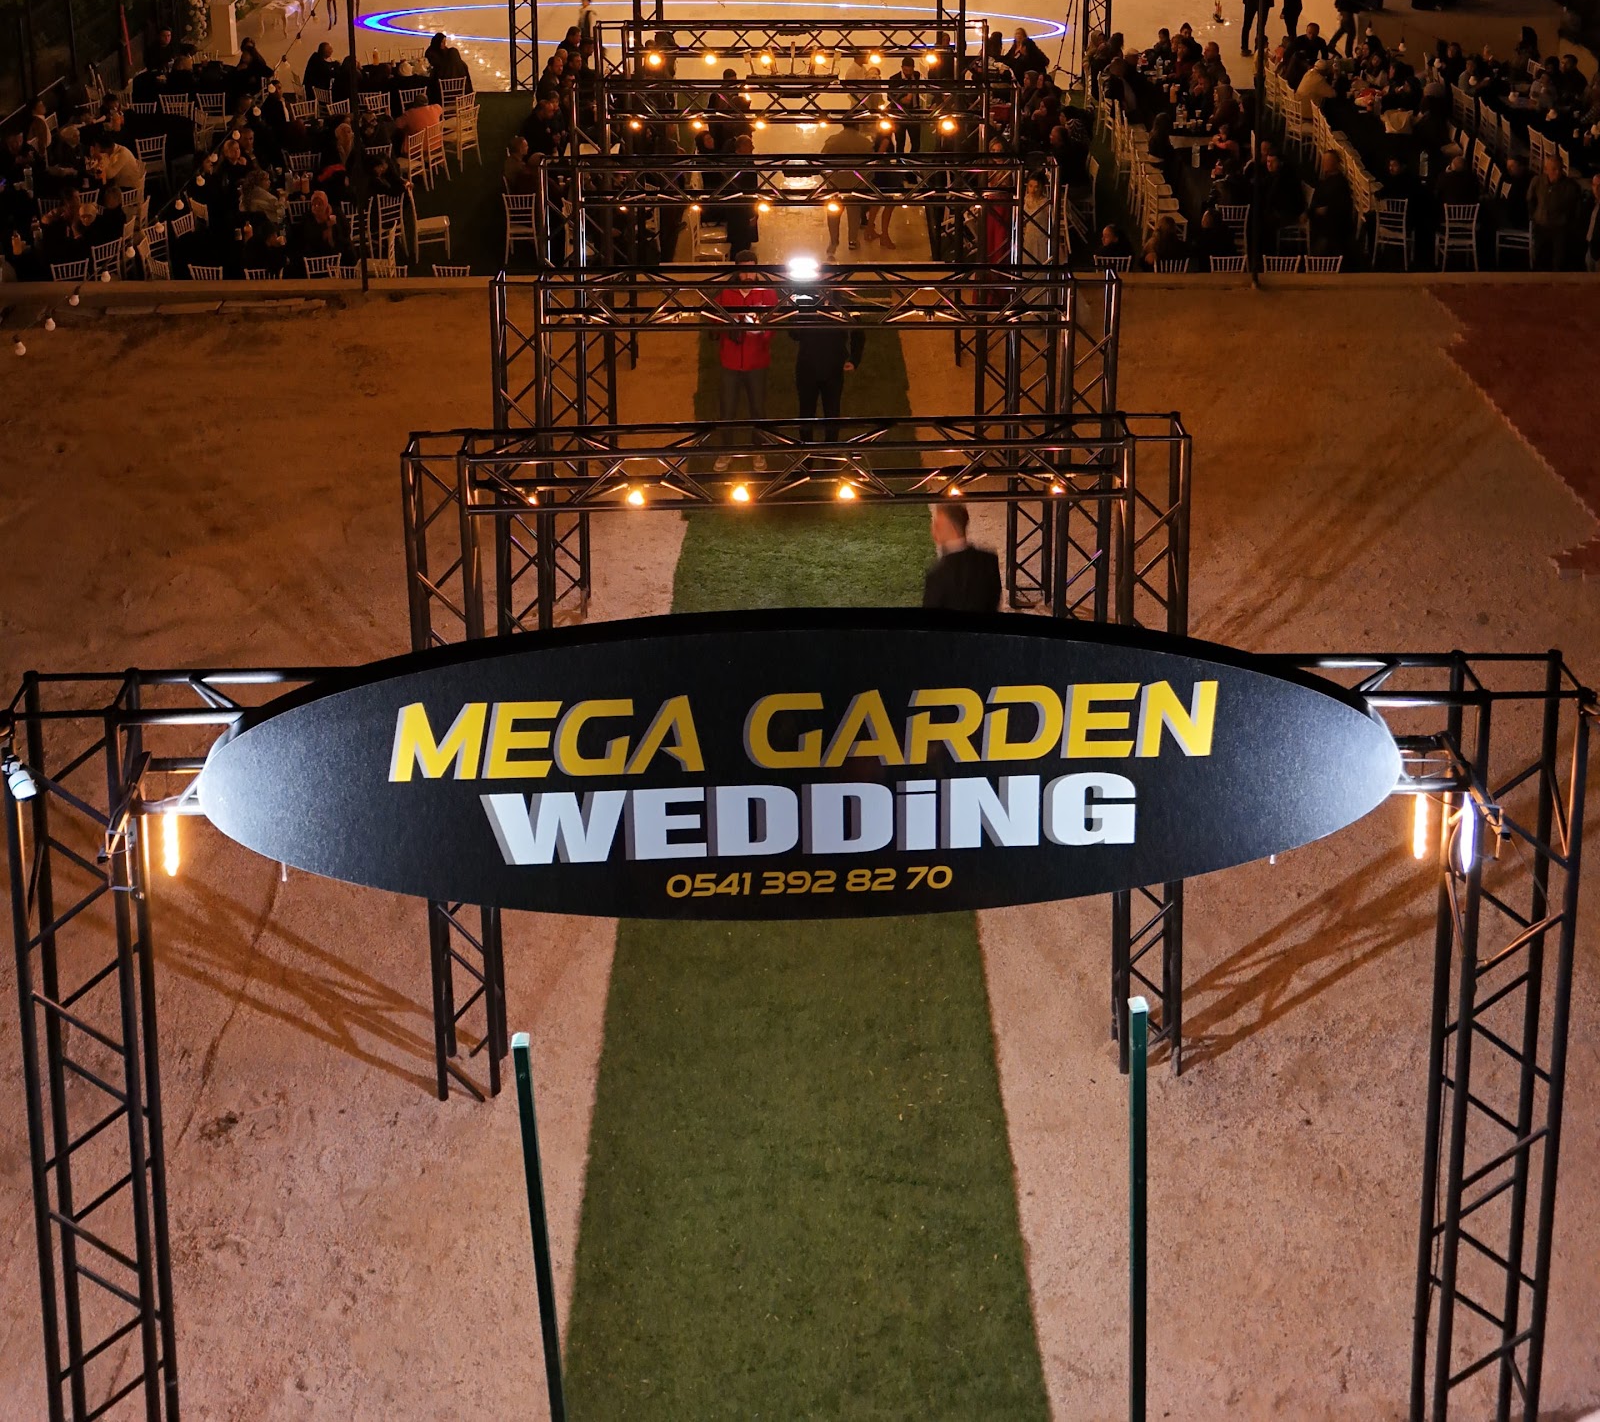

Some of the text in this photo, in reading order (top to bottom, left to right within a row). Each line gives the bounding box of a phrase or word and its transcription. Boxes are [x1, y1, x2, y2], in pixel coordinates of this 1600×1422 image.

[387, 680, 1219, 783] MEGA GARDEN
[665, 865, 953, 899] 0541 392 82 70
